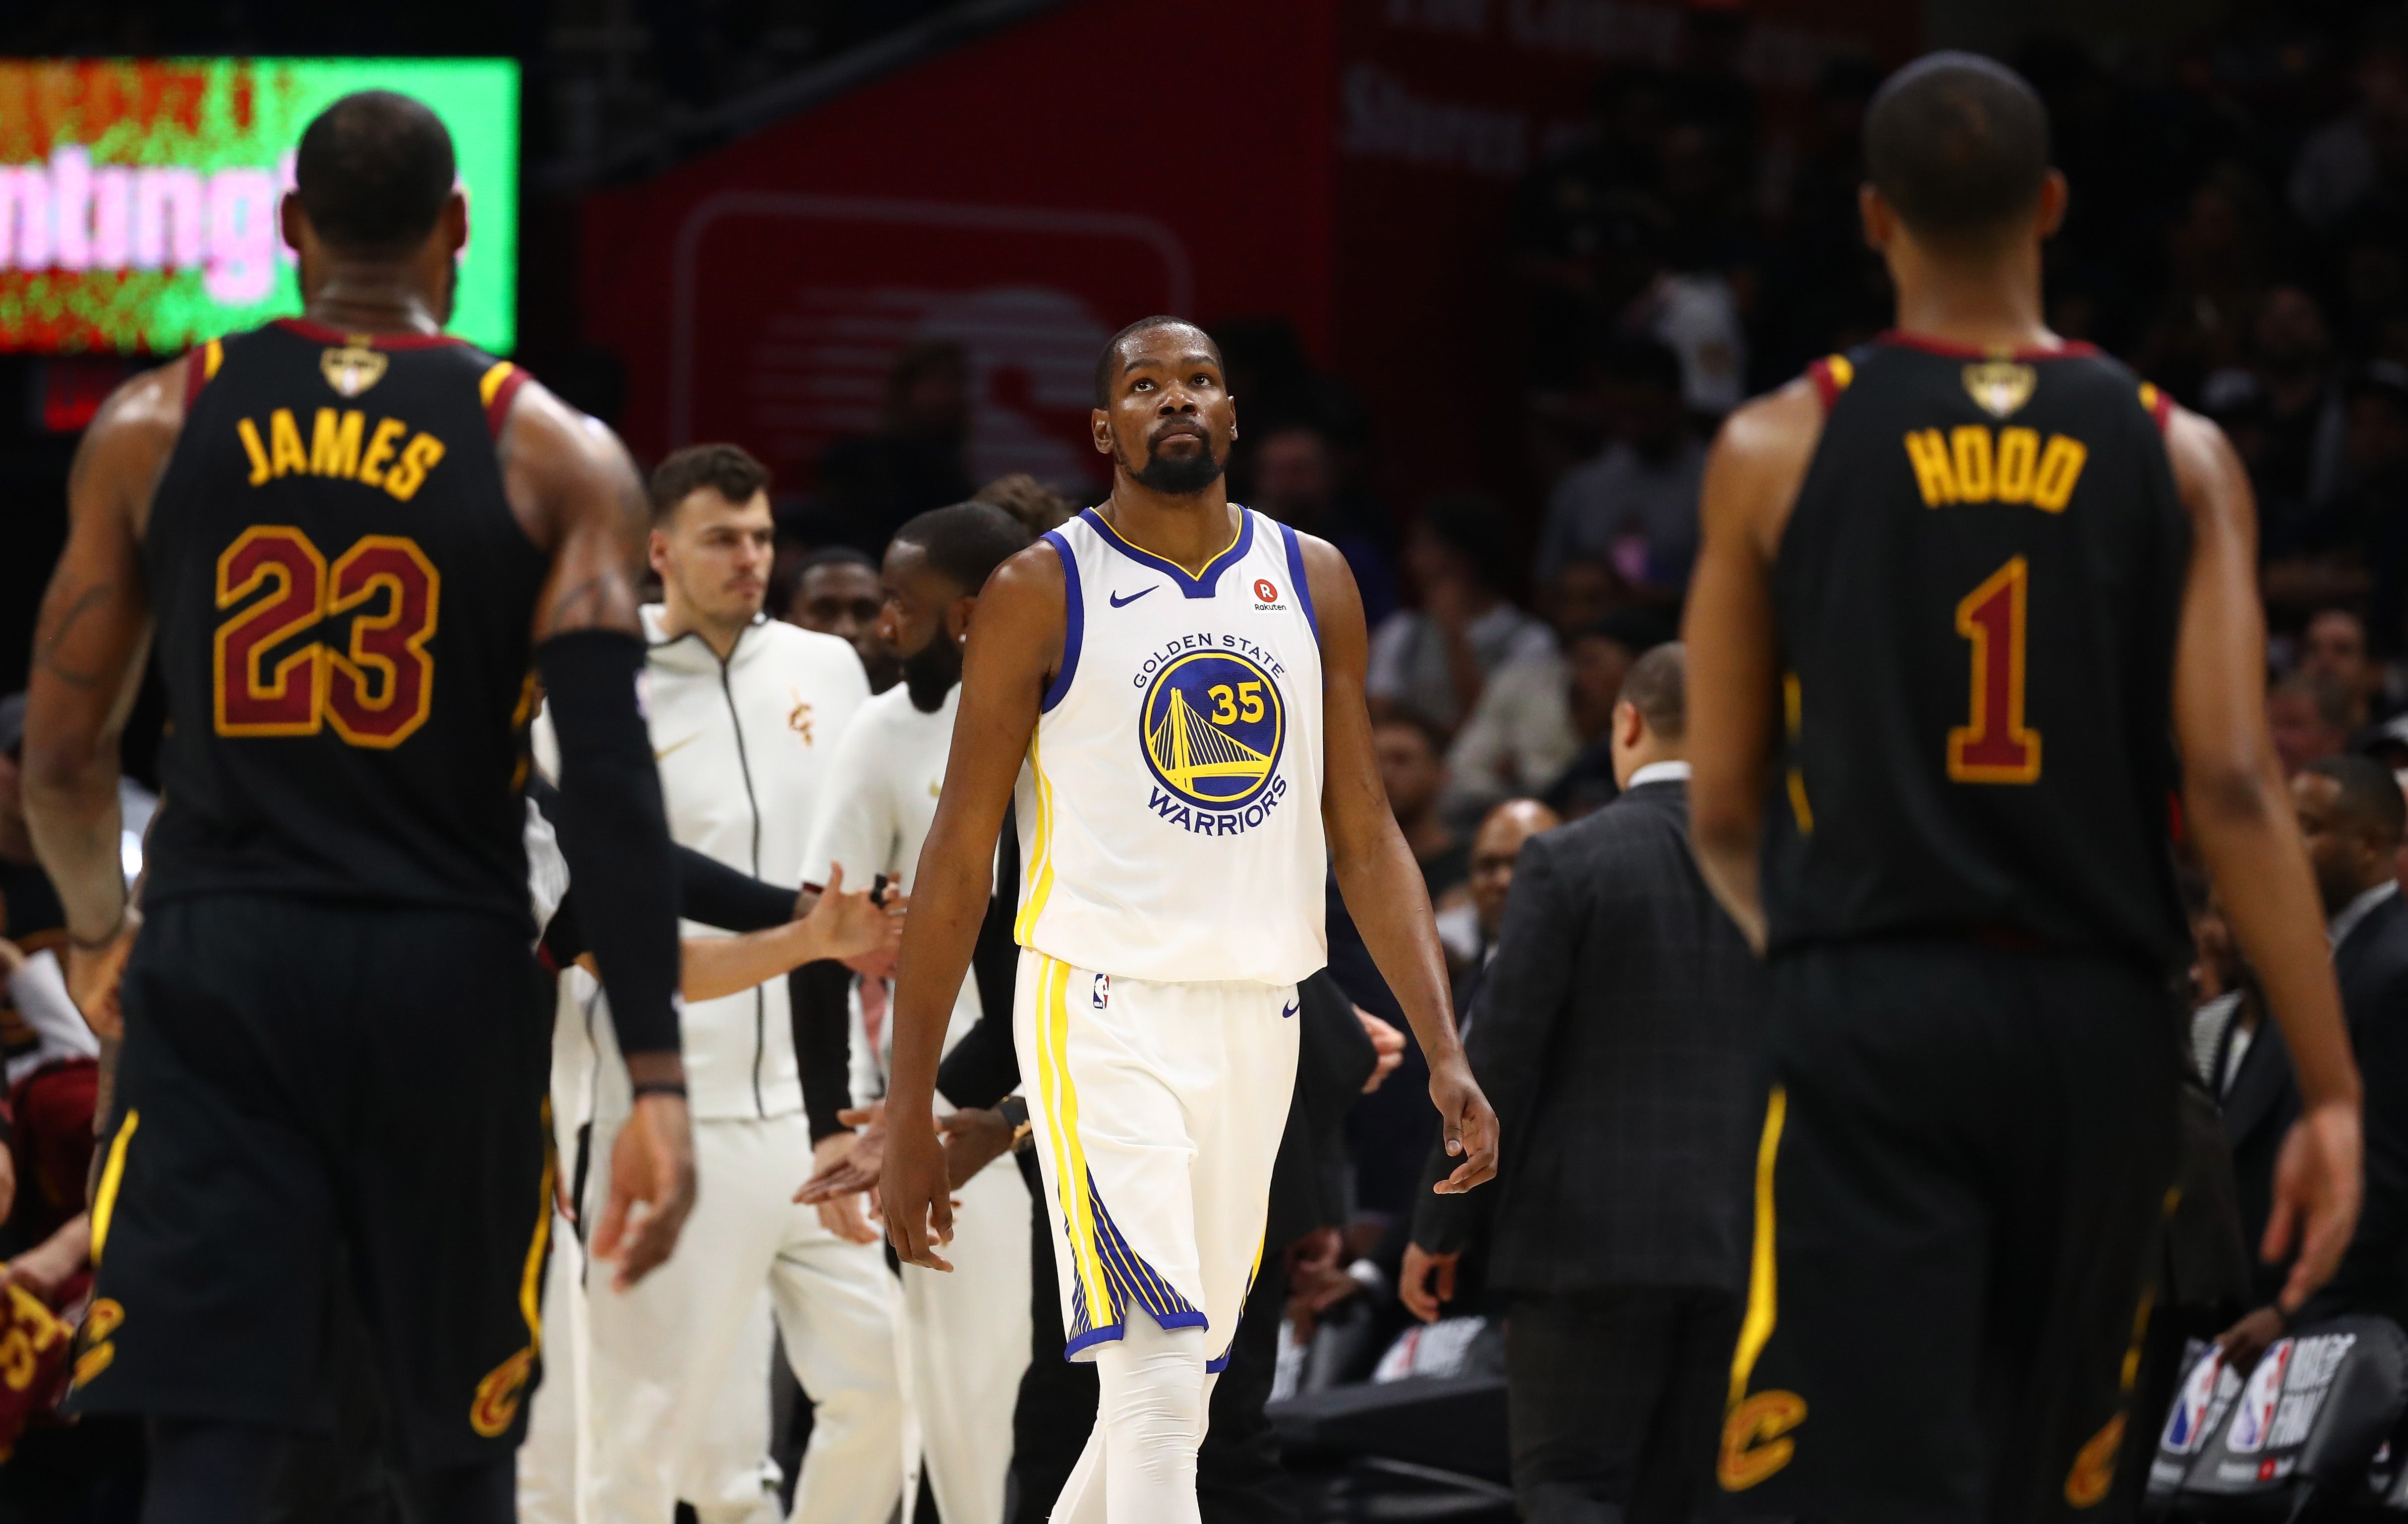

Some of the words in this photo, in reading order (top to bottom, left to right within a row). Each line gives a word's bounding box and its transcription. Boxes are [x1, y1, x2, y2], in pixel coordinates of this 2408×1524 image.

[236, 407, 446, 502] JAMES
[1903, 424, 2088, 514] HOOD
[1259, 584, 1274, 598] R
[213, 524, 440, 750] 23
[1133, 633, 1213, 689] GOLDEN
[1223, 635, 1285, 679] STATE
[1945, 553, 2043, 785] 1
[1208, 680, 1265, 726] 35
[1148, 773, 1287, 837] WARRIORS
